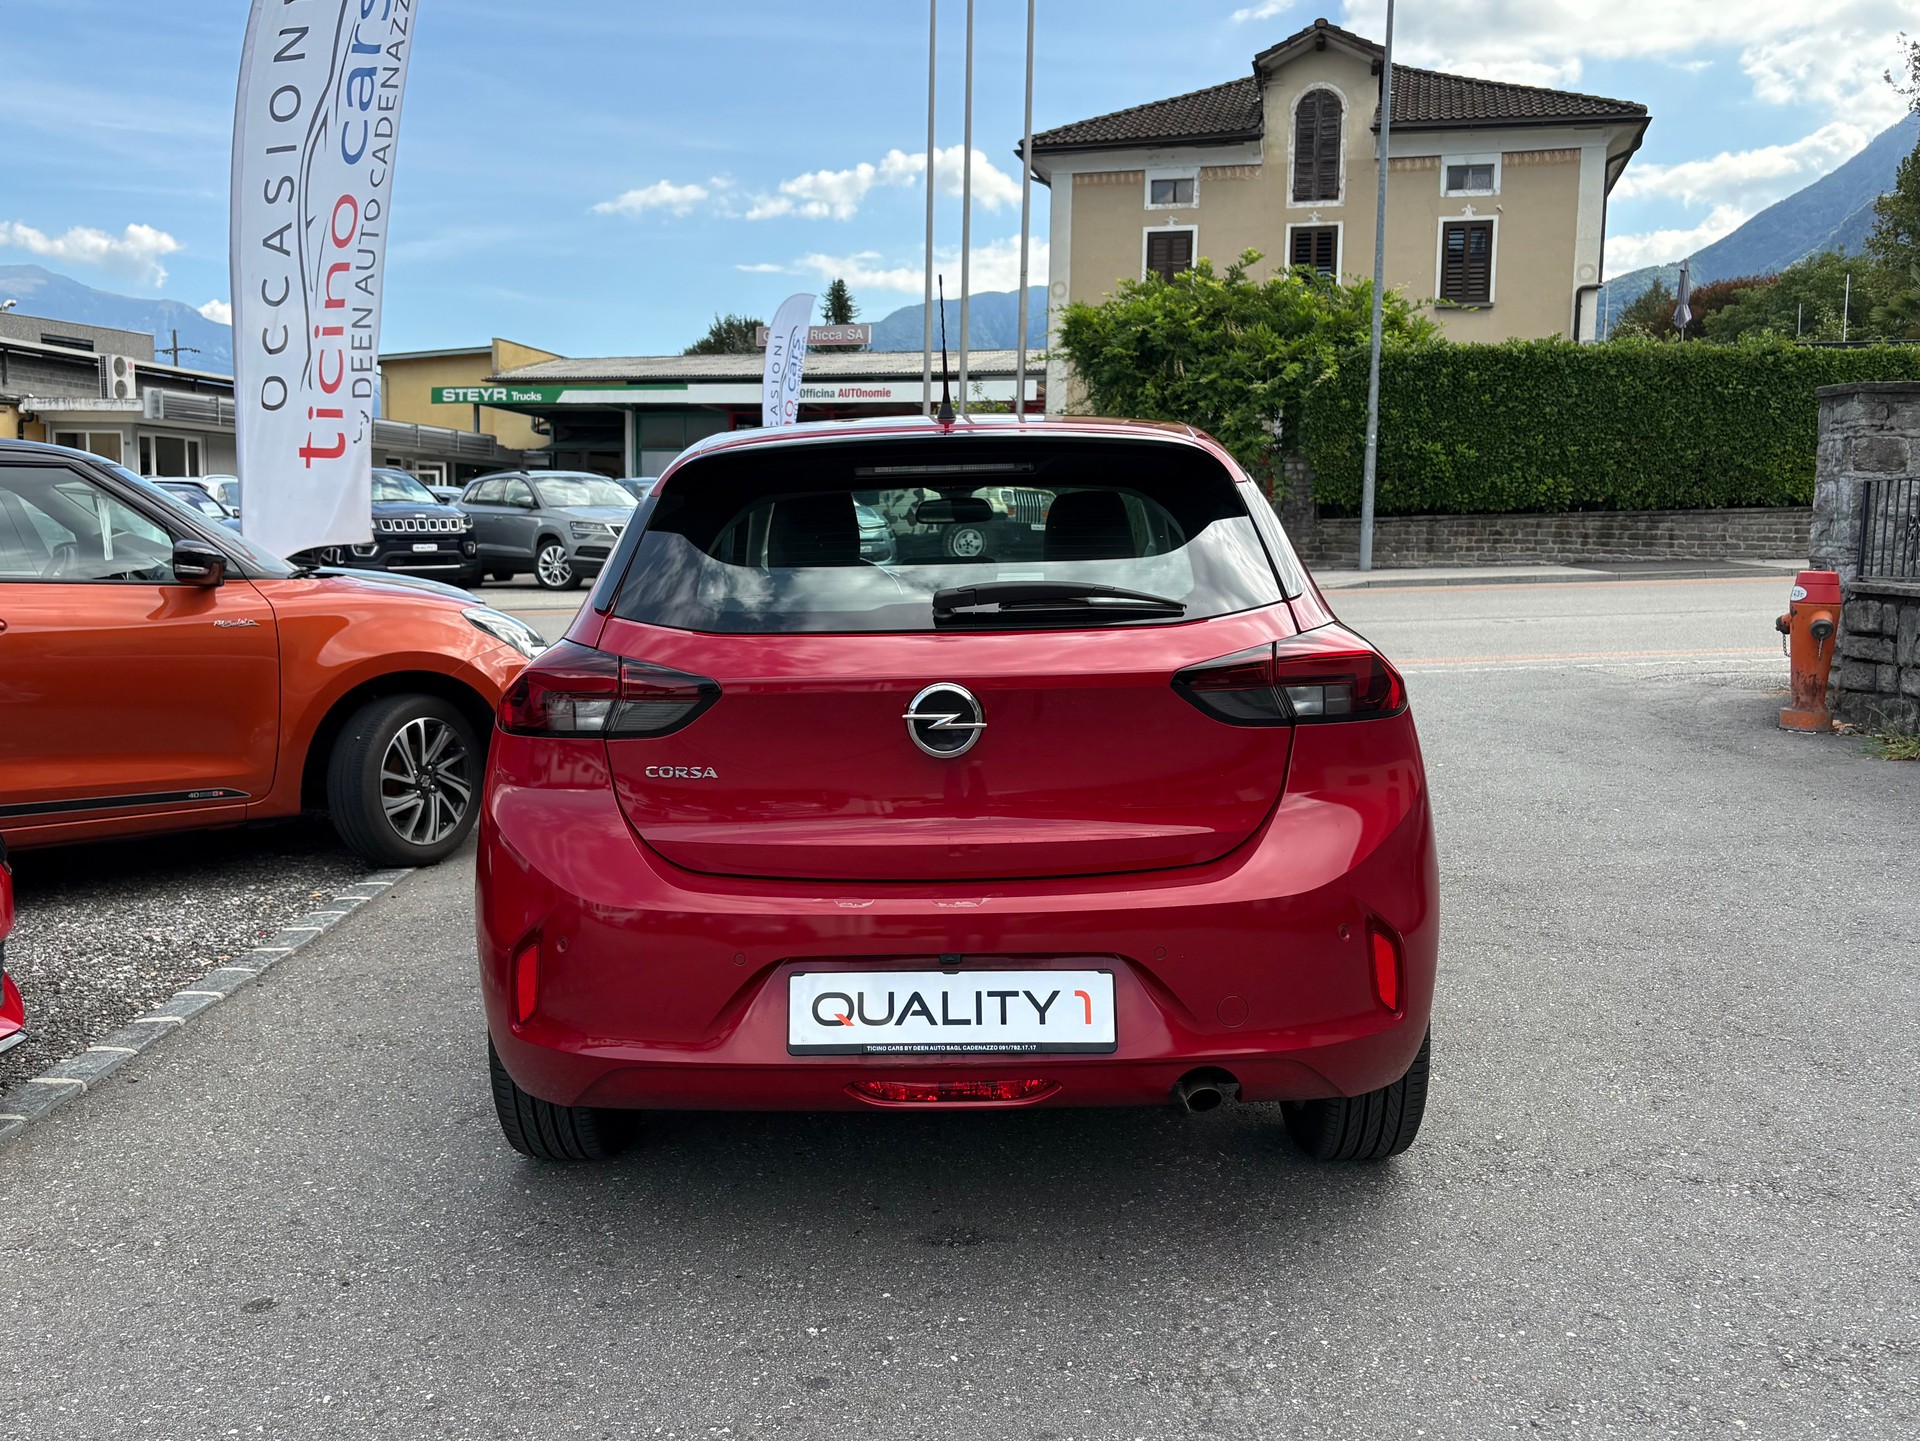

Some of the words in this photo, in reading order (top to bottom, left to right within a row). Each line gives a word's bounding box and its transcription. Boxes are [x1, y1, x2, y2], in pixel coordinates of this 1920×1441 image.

[261, 0, 309, 411] OCCASION
[355, 198, 381, 296] AUTO
[299, 194, 358, 468] ticino
[810, 330, 842, 340] Ricca
[847, 329, 864, 340] SA
[351, 307, 373, 398] DEEN
[442, 388, 507, 402] STEYR
[511, 392, 542, 401] Trucks
[800, 388, 835, 399] Officina
[838, 387, 891, 398] AUTOnomie
[645, 765, 719, 779] CORSA
[812, 989, 1061, 1027] QUALITY
[1074, 990, 1092, 1025] 1
